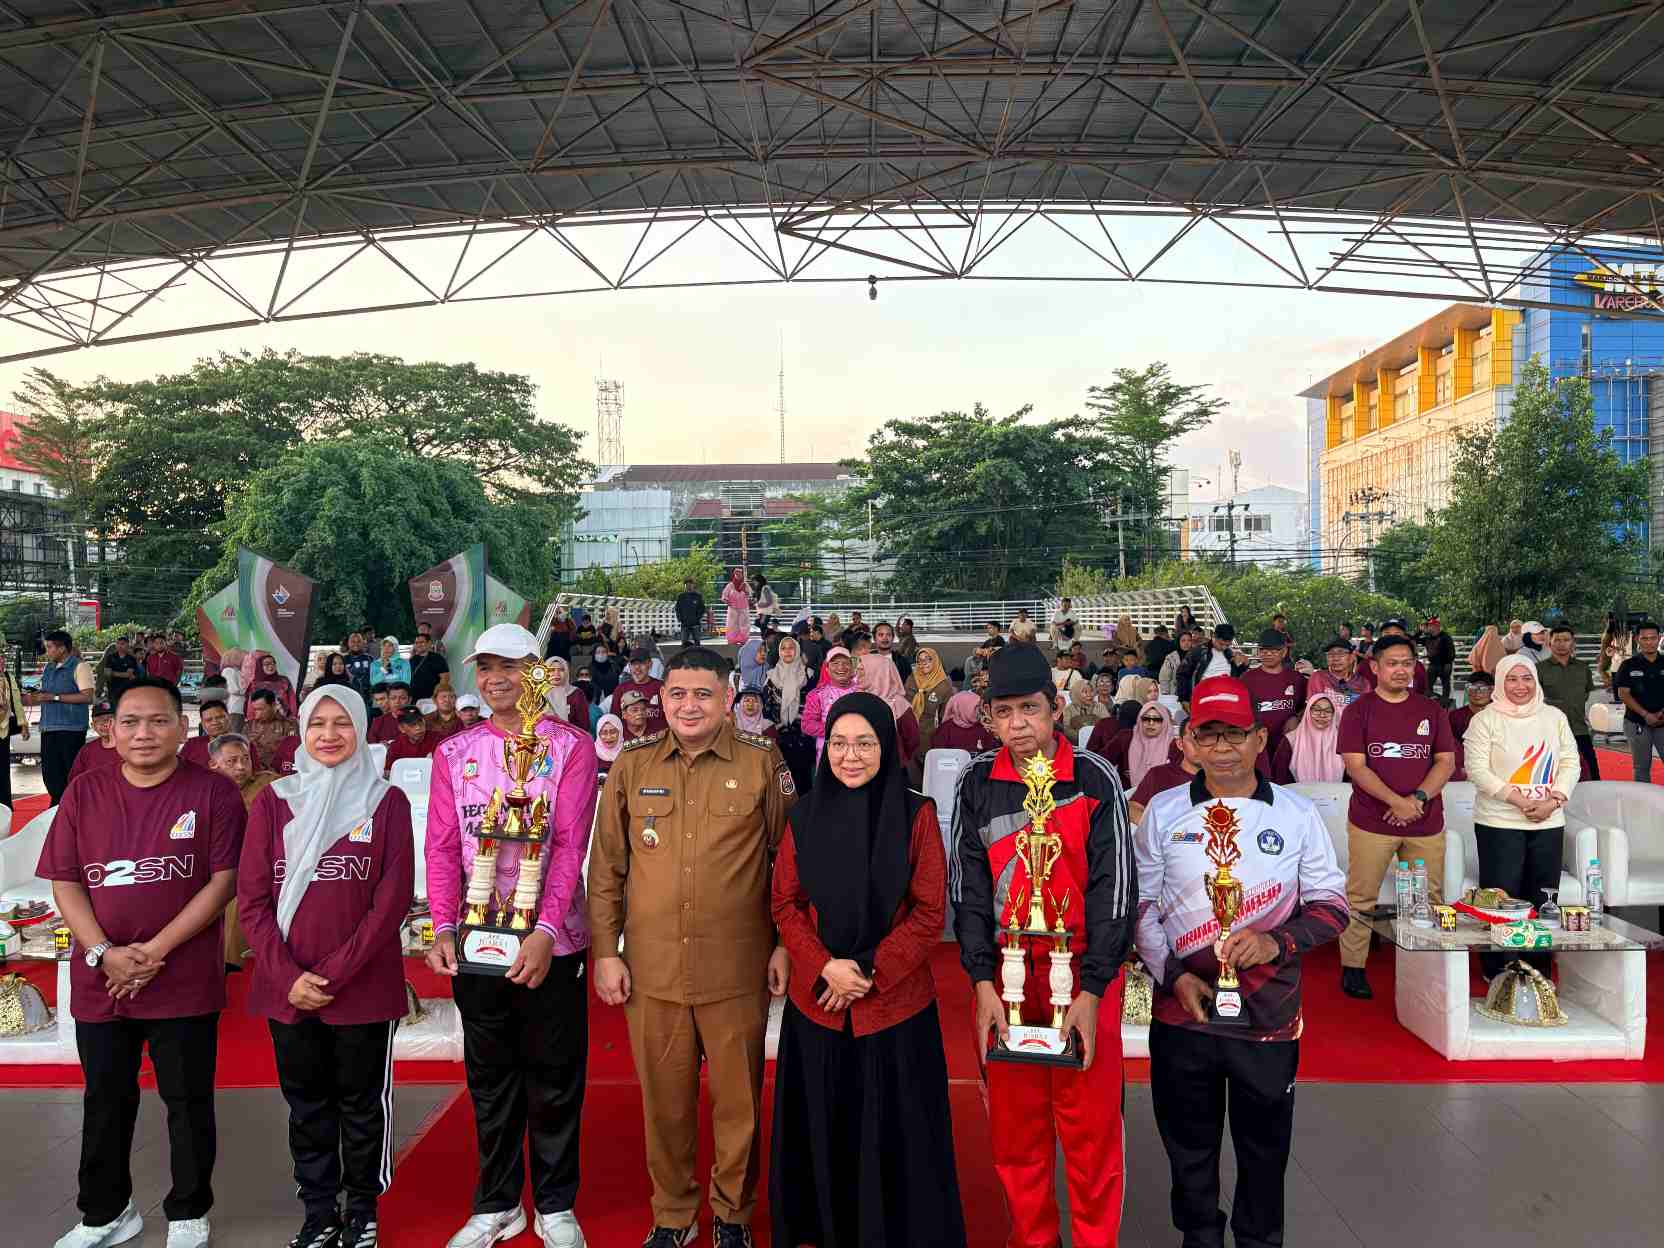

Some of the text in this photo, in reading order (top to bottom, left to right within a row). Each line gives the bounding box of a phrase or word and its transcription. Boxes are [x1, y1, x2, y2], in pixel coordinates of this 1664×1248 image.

[1368, 742, 1431, 759] O2SN
[83, 854, 194, 888] O2SN
[273, 855, 371, 884] OSN
